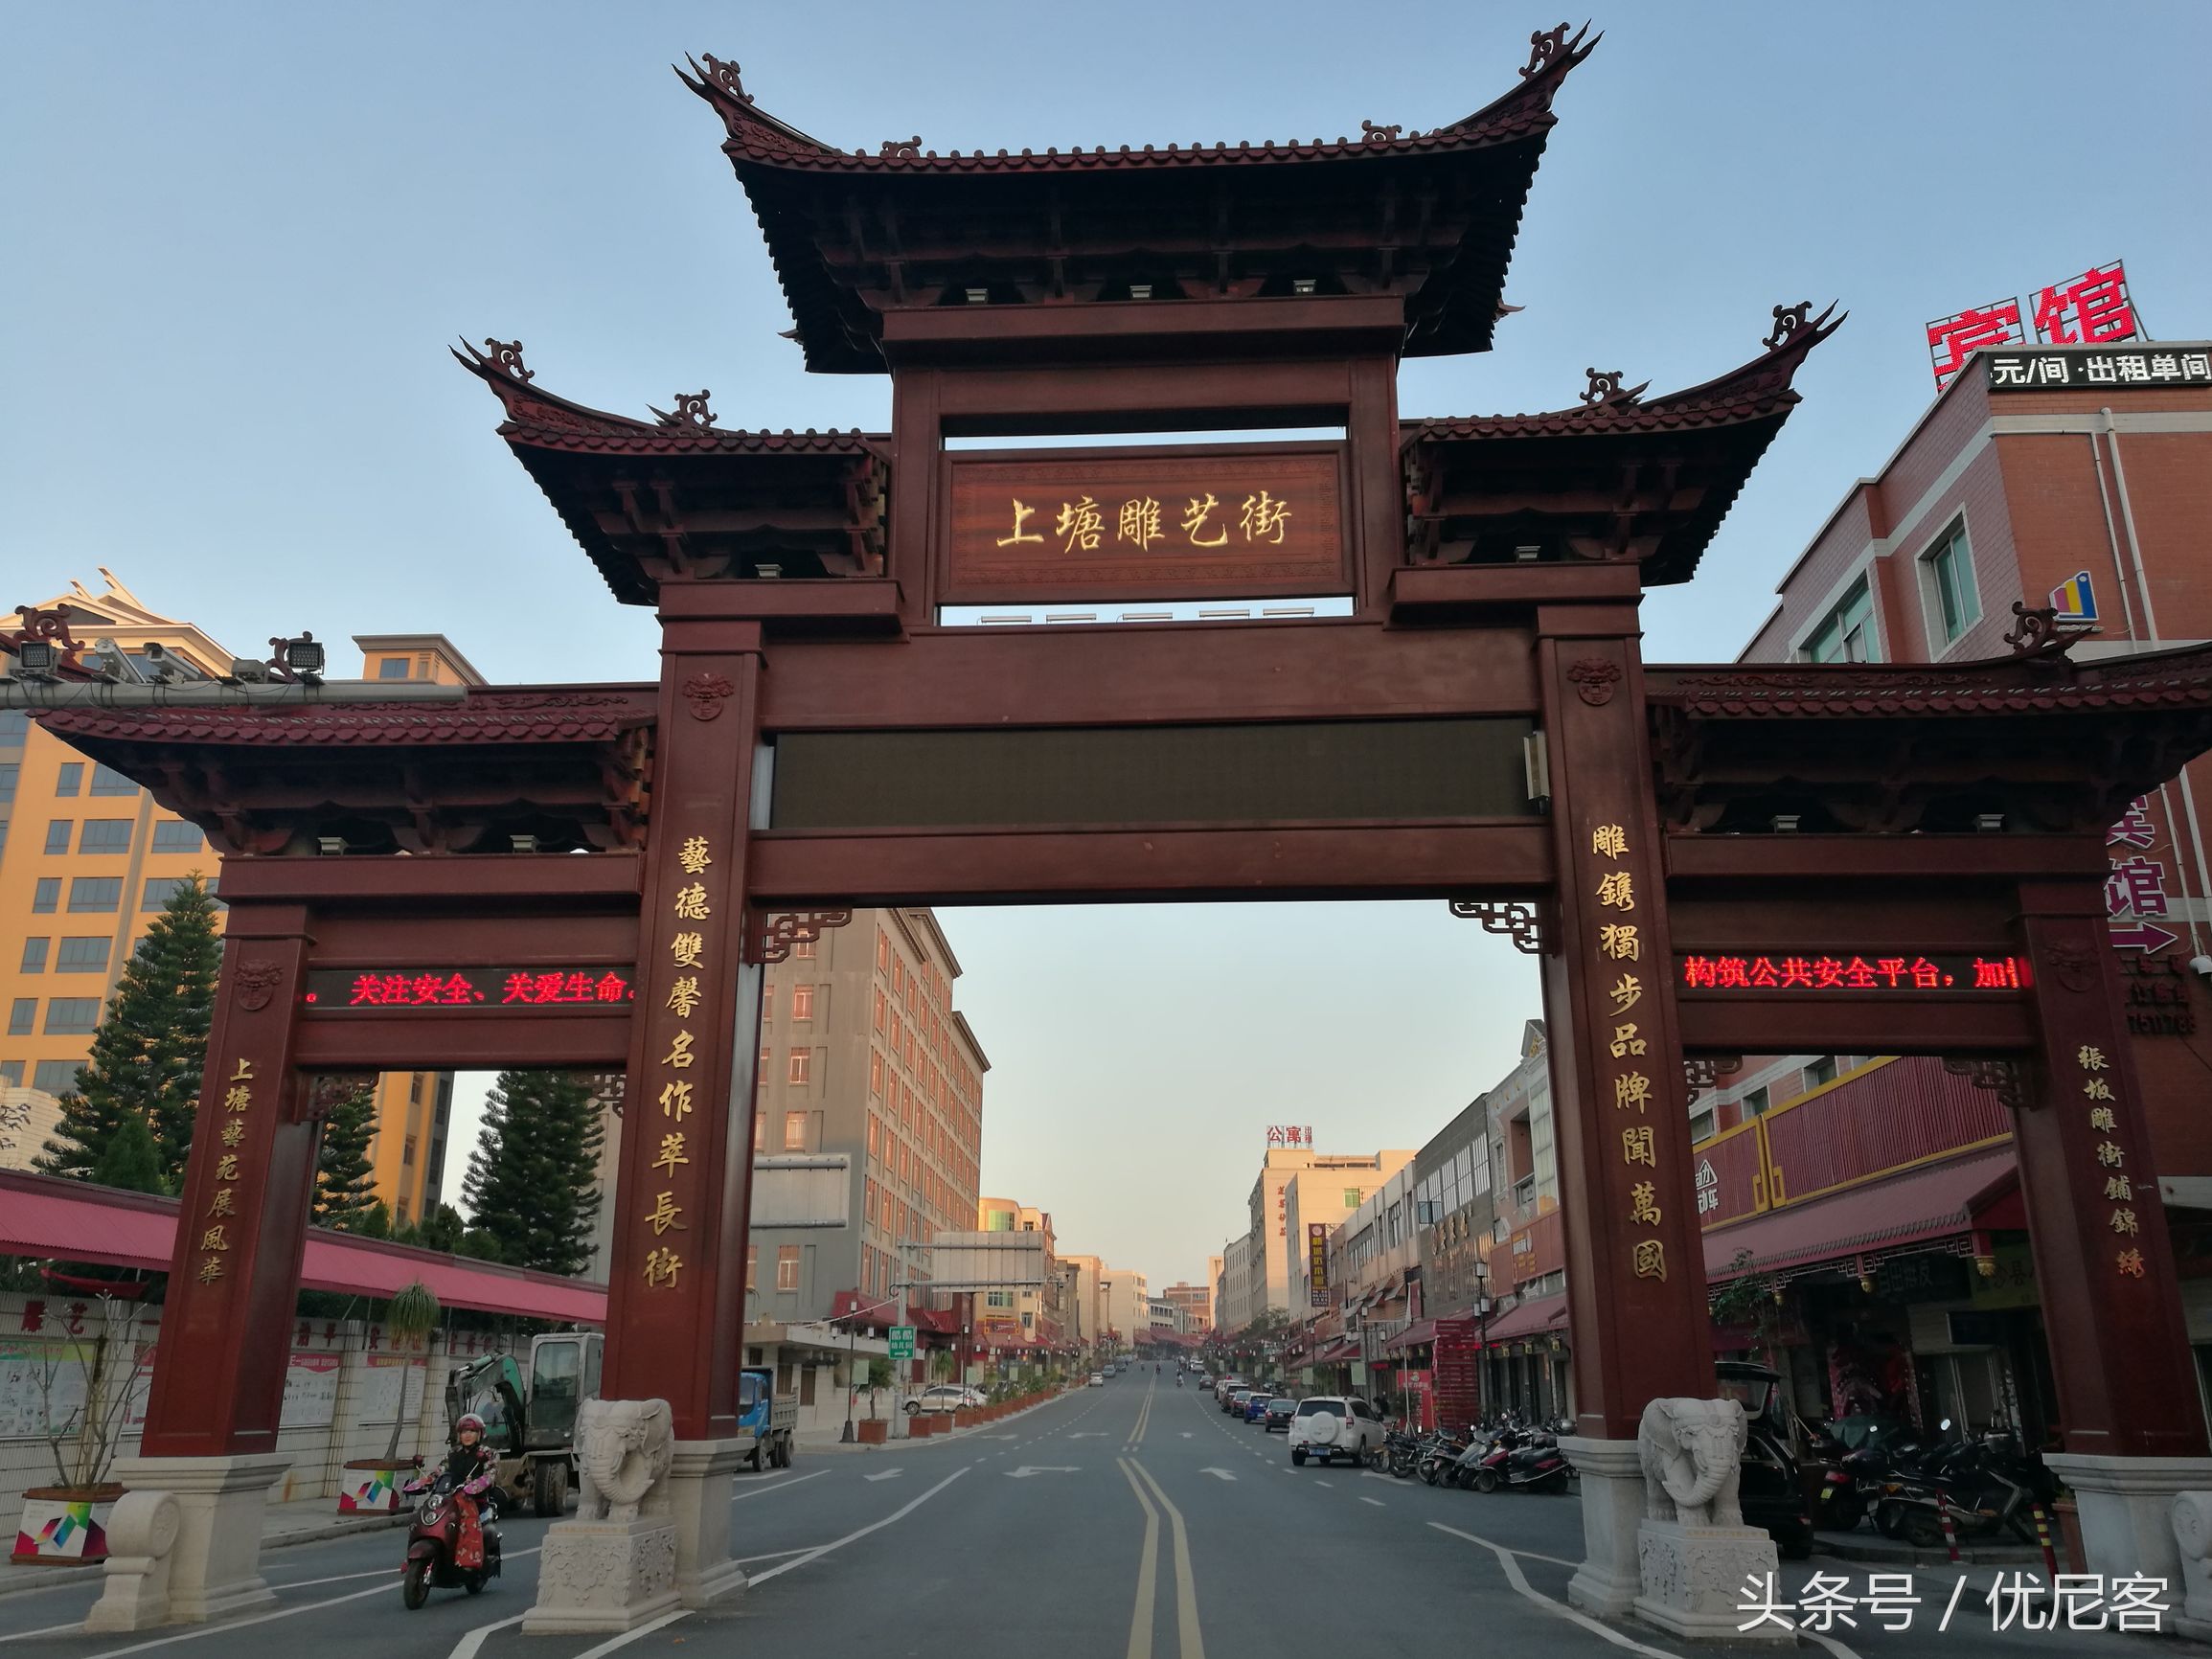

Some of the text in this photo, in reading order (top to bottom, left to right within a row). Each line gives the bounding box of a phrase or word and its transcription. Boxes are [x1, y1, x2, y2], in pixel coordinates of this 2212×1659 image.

[996, 489, 1292, 554] 上塘雕艺街
[1267, 1126, 1301, 1143] 公寓
